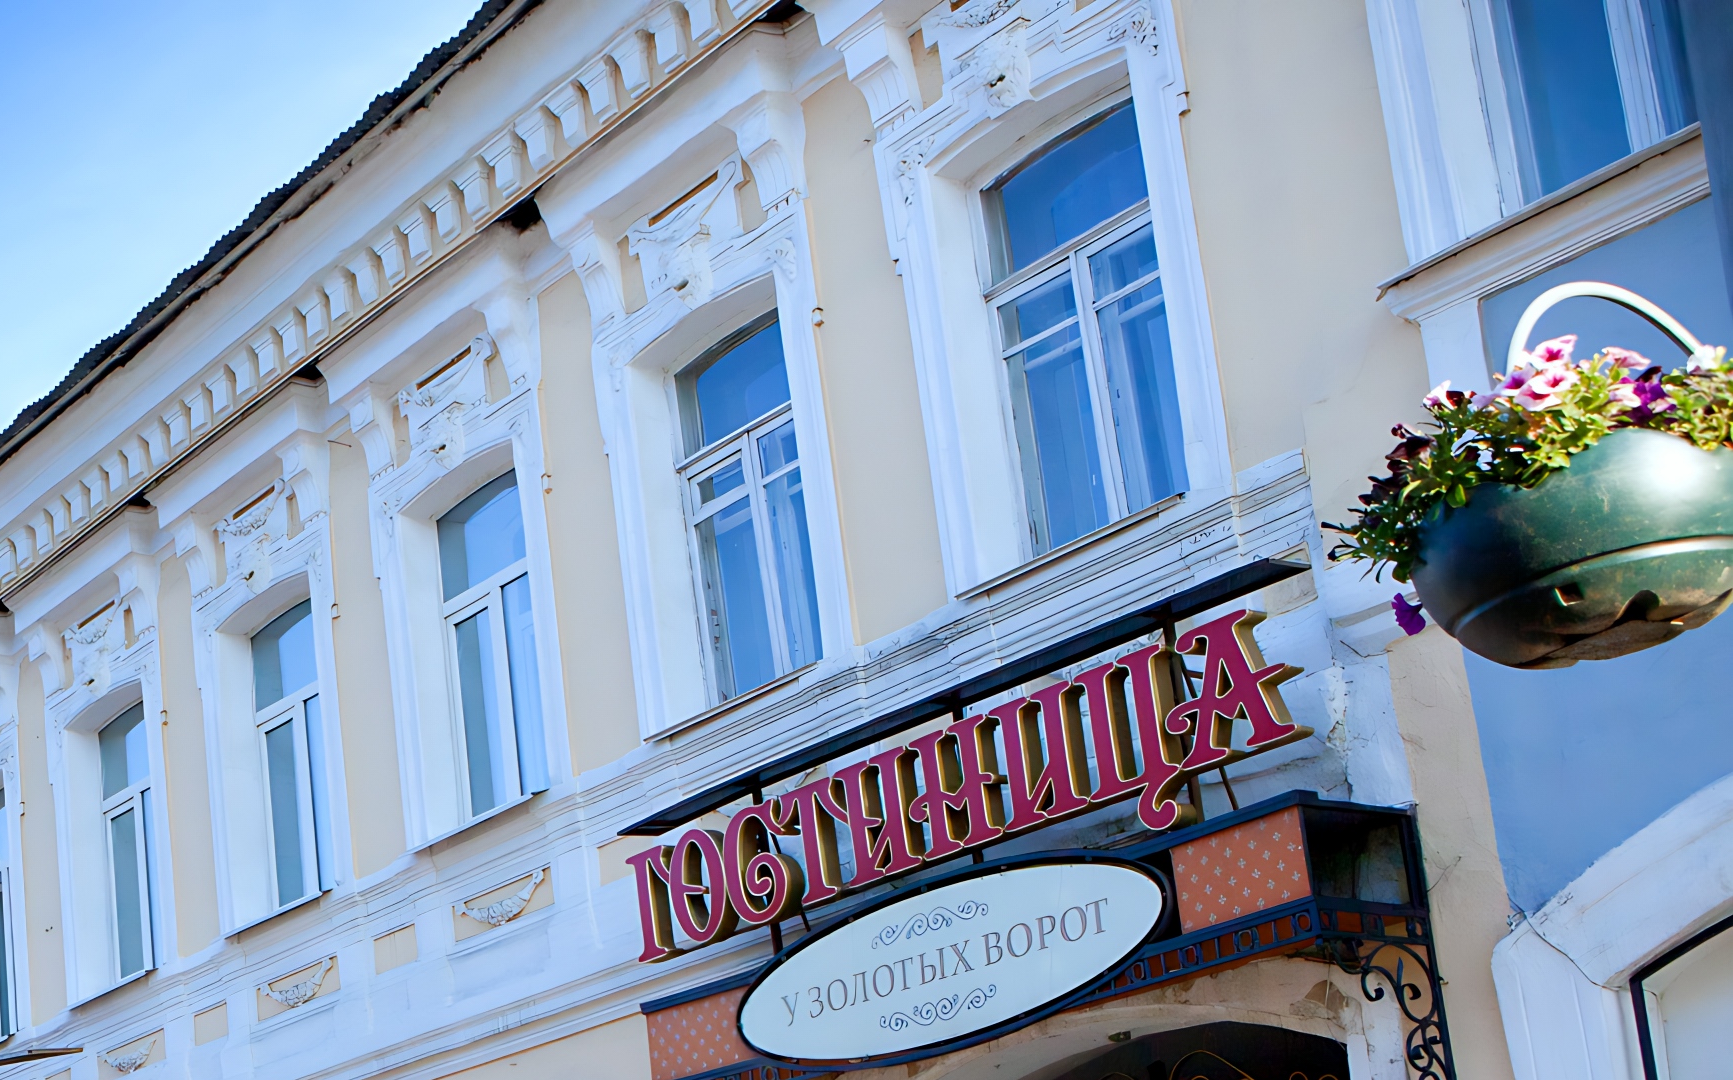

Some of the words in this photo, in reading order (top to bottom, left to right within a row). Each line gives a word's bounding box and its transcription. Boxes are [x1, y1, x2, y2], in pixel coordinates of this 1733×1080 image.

[625, 608, 1307, 963] ГОСТИНИЦА
[779, 990, 801, 1027] У
[808, 939, 976, 1019] ЗОЛОТЫХ
[983, 897, 1111, 967] ВОРОТ
